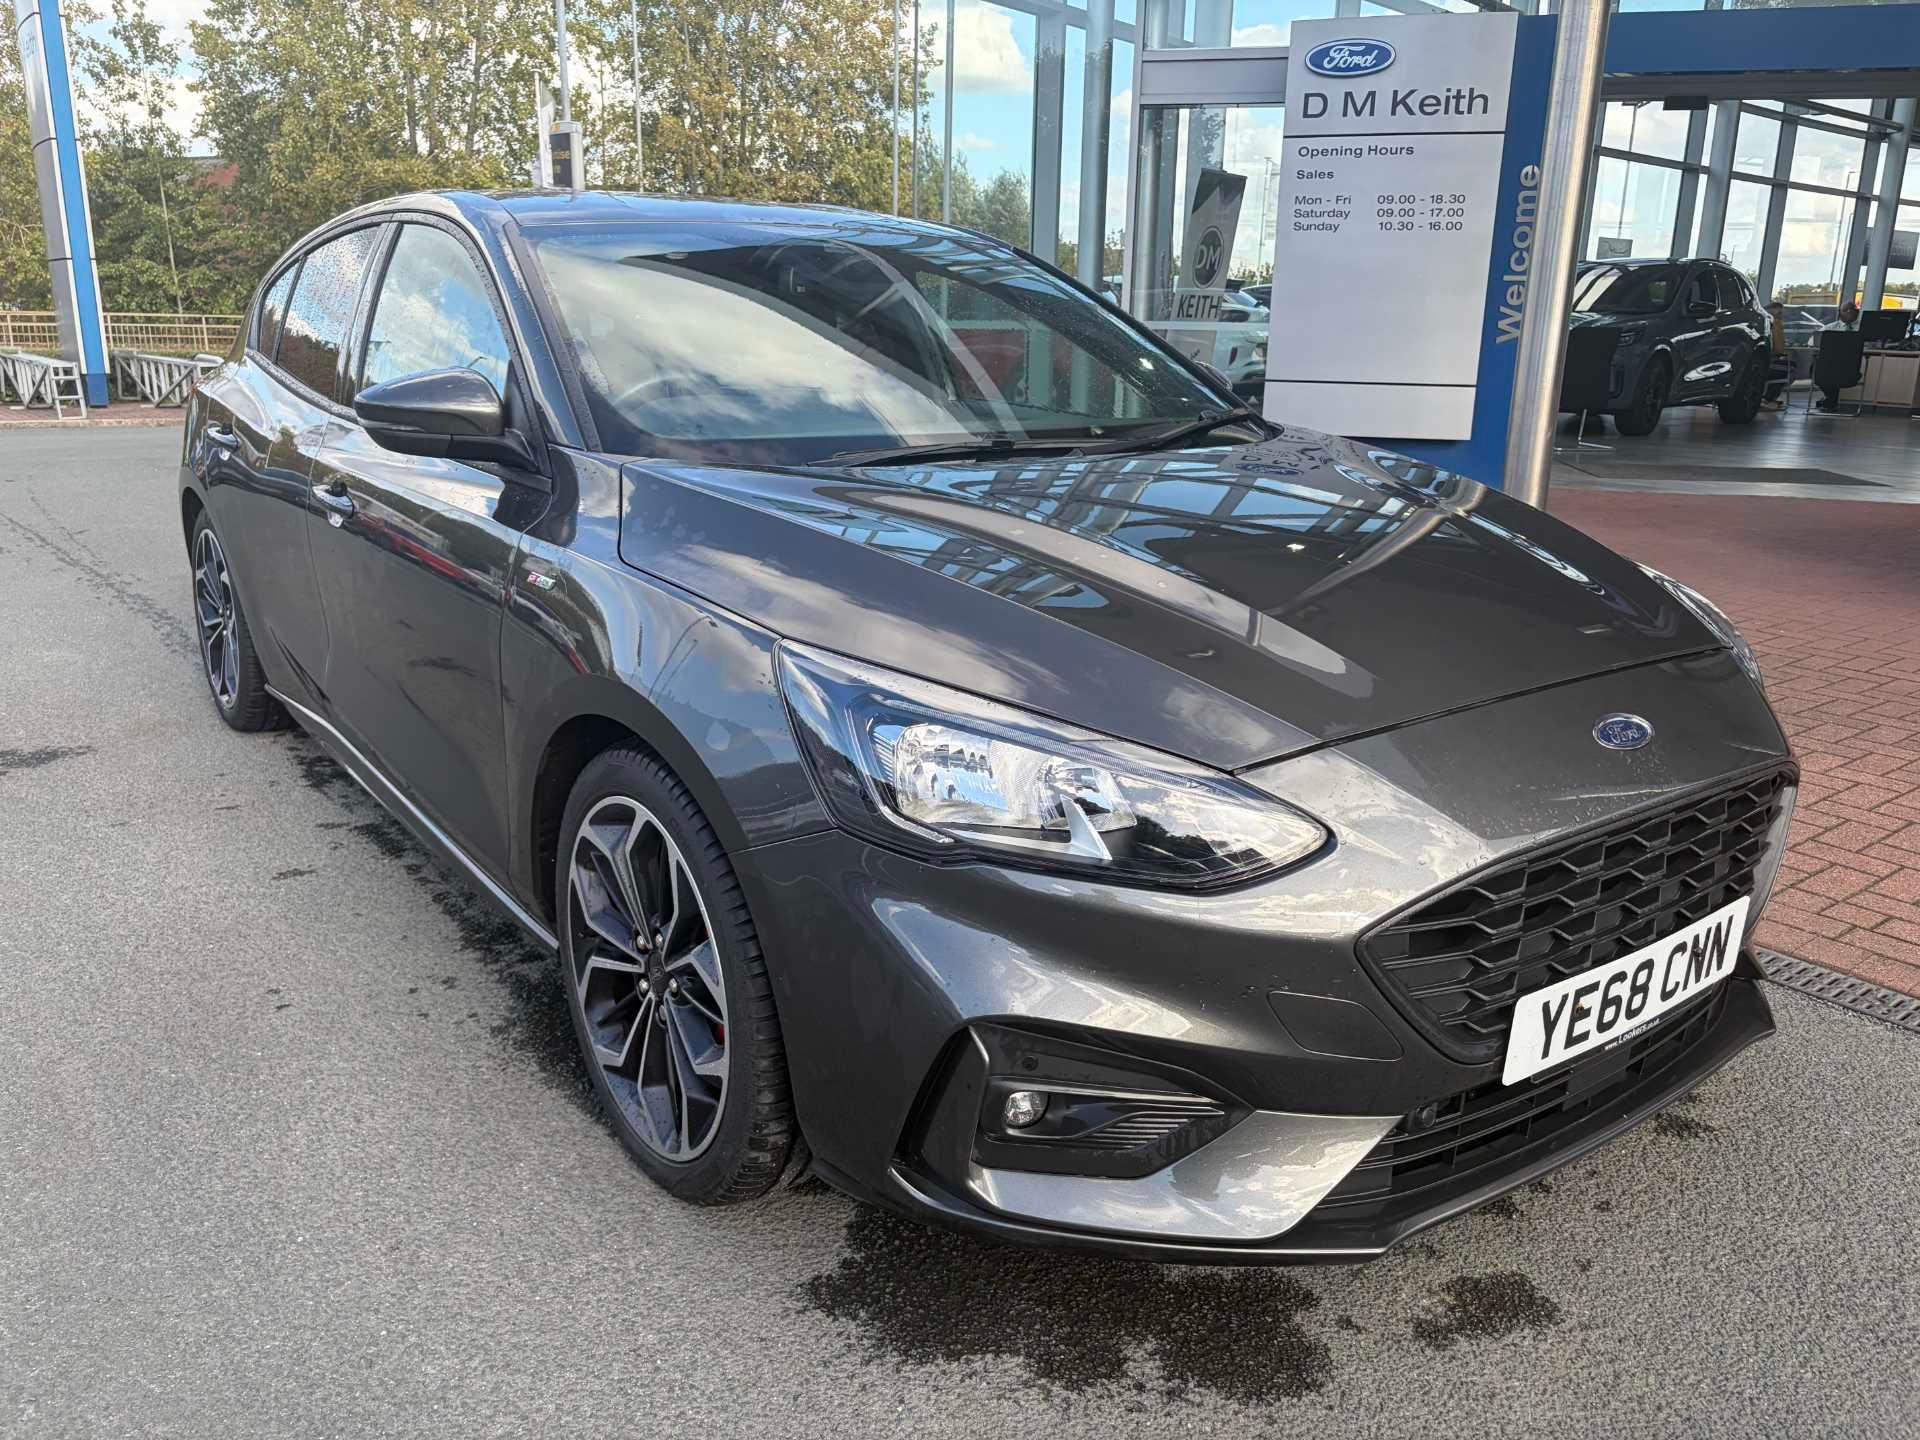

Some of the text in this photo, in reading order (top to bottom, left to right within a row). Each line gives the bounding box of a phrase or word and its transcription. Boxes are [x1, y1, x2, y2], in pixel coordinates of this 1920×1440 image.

[1323, 45, 1378, 69] Ford
[1303, 87, 1489, 118] D M Keith
[1298, 145, 1415, 159] Opening Hours
[1296, 169, 1335, 180] Sales
[1294, 195, 1322, 206] Mon
[1335, 195, 1352, 205] Fri
[1377, 194, 1416, 205] 09.00
[1429, 194, 1466, 204] 18.30
[1293, 208, 1351, 220] Saturday
[1376, 208, 1415, 218] 09.00
[1428, 207, 1464, 217] 17.00
[1293, 221, 1341, 233] Sunday
[1378, 221, 1414, 231] 10.30
[1427, 221, 1463, 231] 16.00
[1195, 243, 1220, 272] DM
[1495, 164, 1541, 344] Welcome
[1176, 293, 1220, 320] KEITH
[1541, 914, 1734, 1060] YE68 CNN
